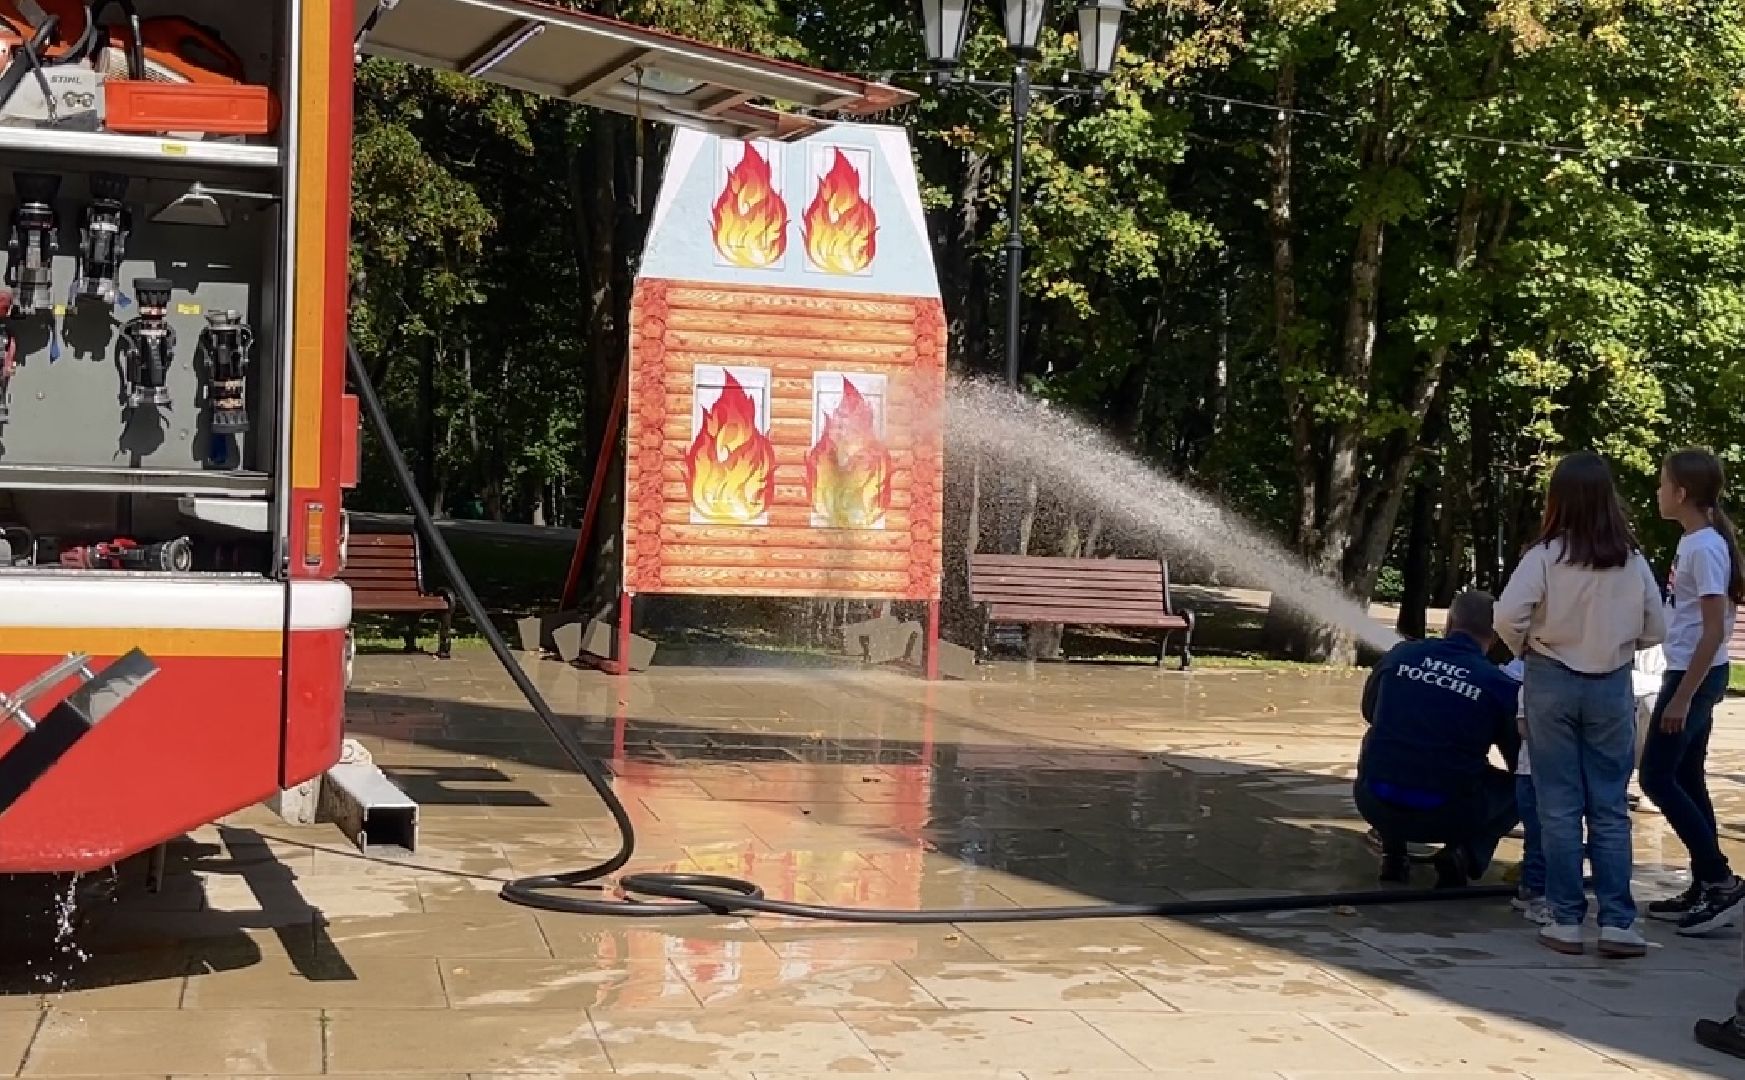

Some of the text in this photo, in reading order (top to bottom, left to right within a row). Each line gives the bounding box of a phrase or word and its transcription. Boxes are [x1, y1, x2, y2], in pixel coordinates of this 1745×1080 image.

[51, 75, 82, 84] STIHL
[1420, 656, 1471, 679] МЧС
[1397, 664, 1482, 701] РОССИИ
